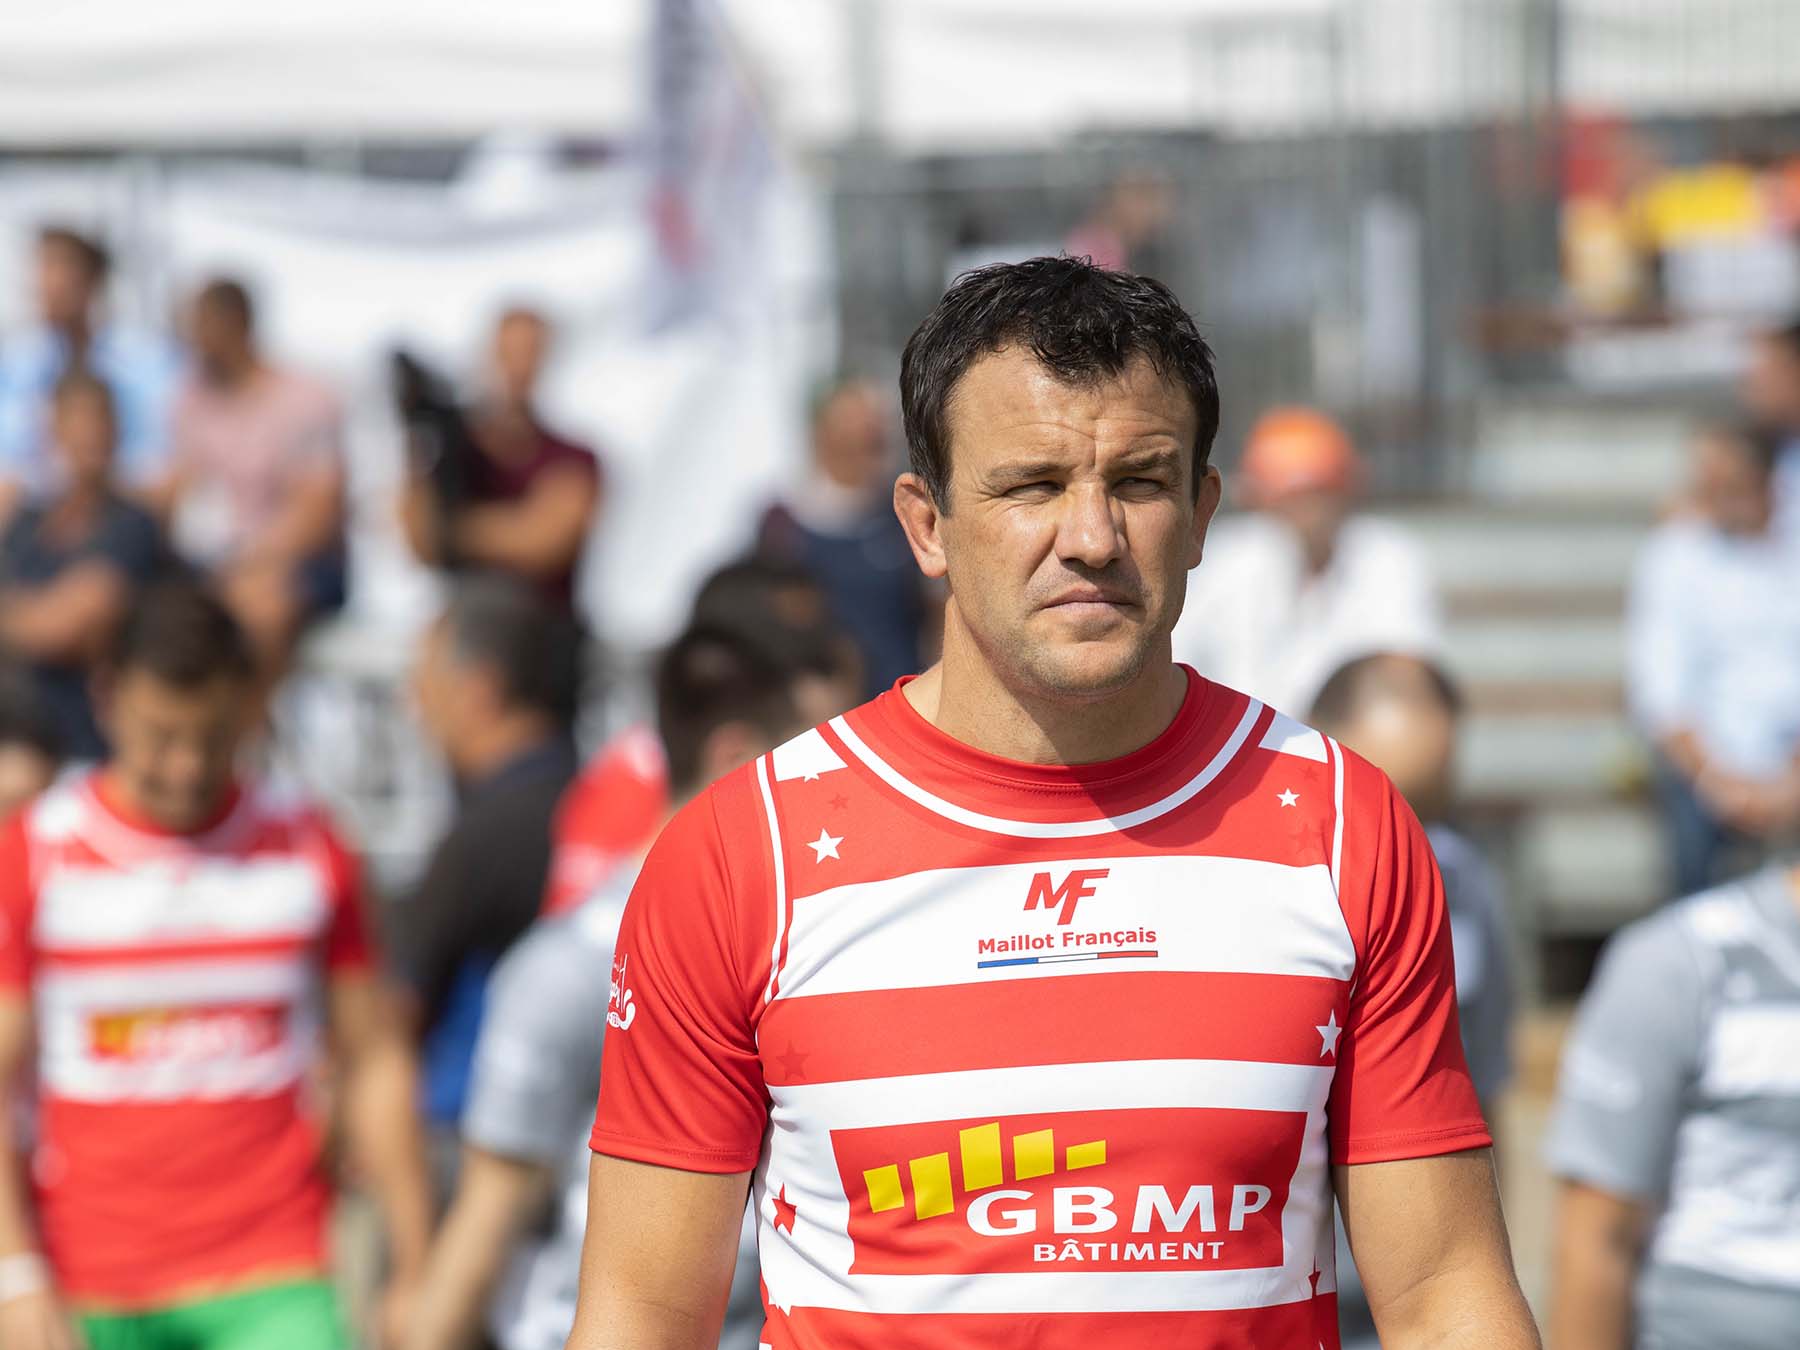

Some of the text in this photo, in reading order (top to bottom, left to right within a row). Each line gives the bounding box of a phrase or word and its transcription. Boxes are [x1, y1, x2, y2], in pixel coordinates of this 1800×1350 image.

[1023, 868, 1110, 925] MF
[977, 928, 1157, 954] Maillot Français
[966, 1185, 1272, 1236] GBMP
[1033, 1239, 1225, 1262] BÂTIMENT
